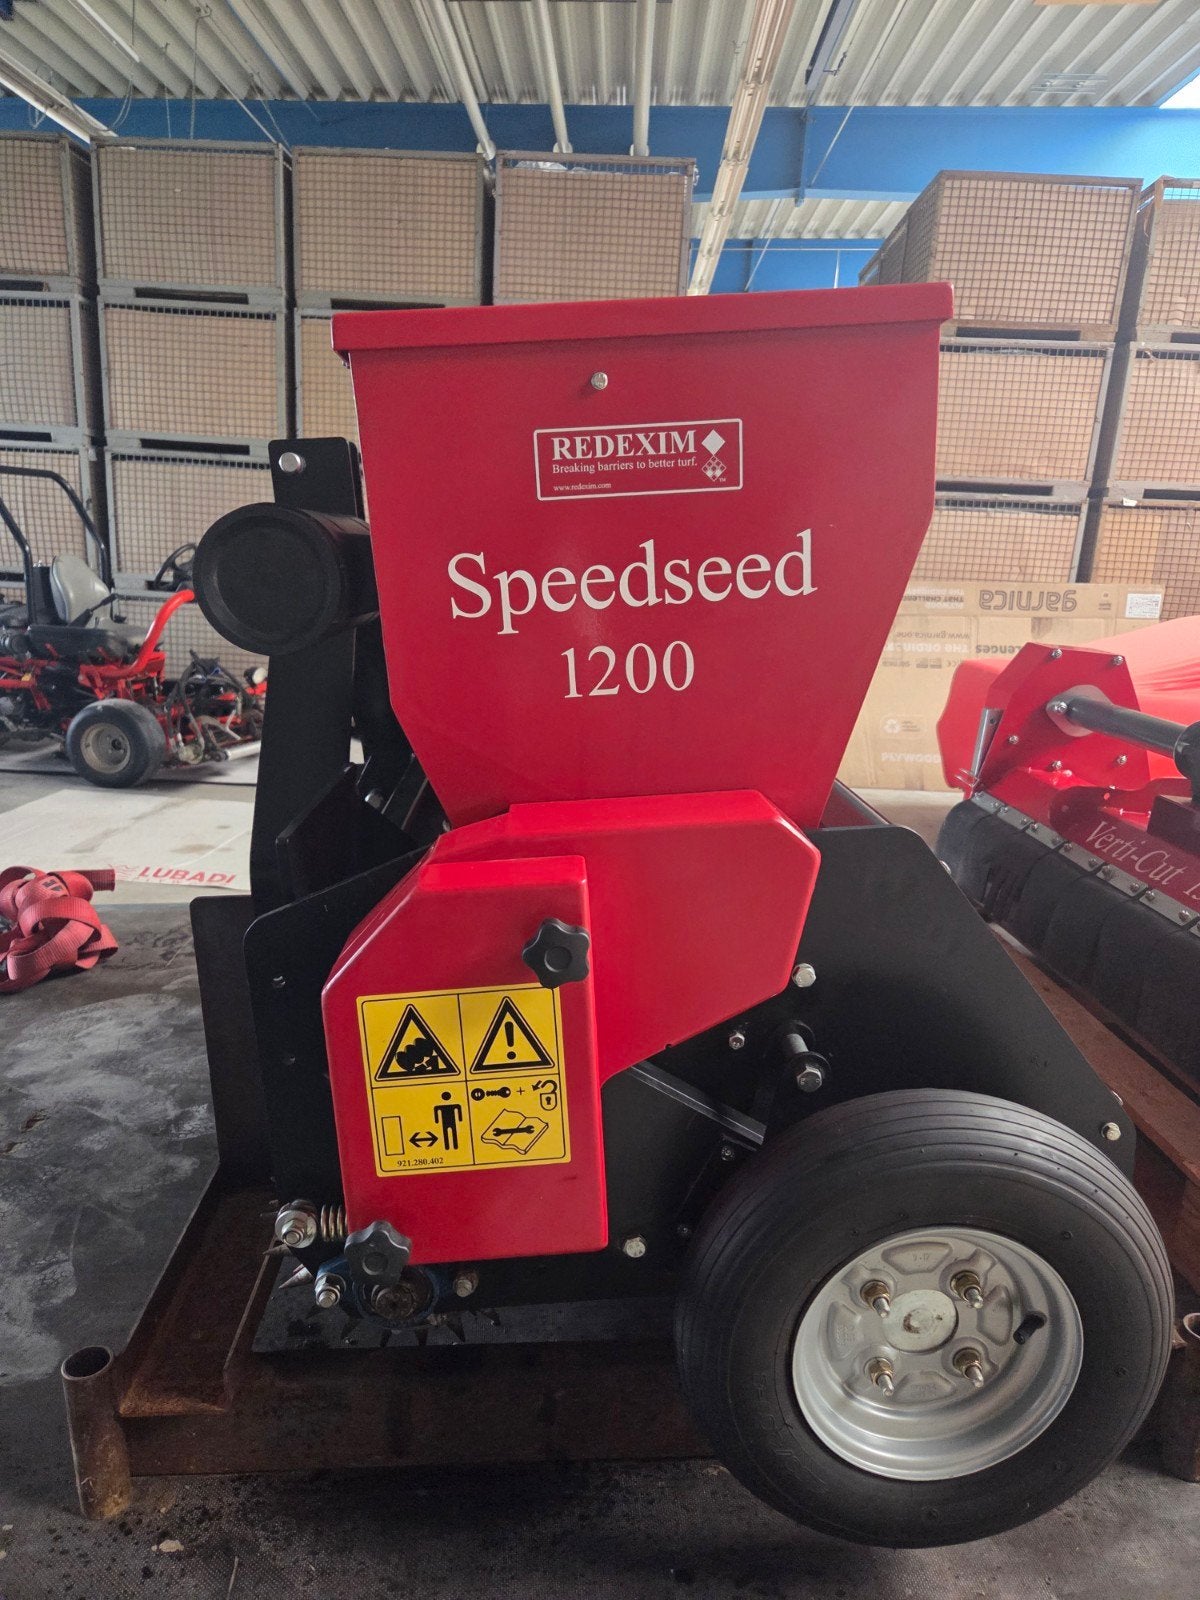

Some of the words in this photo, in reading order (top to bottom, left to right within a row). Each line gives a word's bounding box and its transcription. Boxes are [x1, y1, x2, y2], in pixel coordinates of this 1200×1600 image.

[552, 430, 697, 460] REDEXIM
[552, 463, 596, 475] Breaking
[597, 461, 634, 472] barriers
[636, 460, 646, 469] to
[648, 458, 675, 469] better
[677, 456, 698, 468] turf.
[553, 482, 612, 491] www.redexim.com
[447, 528, 818, 635] Speedseed
[979, 590, 1077, 612] garnica
[561, 640, 695, 699] 1200
[1085, 821, 1188, 885] Verti-Cut
[139, 867, 236, 884] LUBADI
[397, 1158, 443, 1167] 921.280.402
